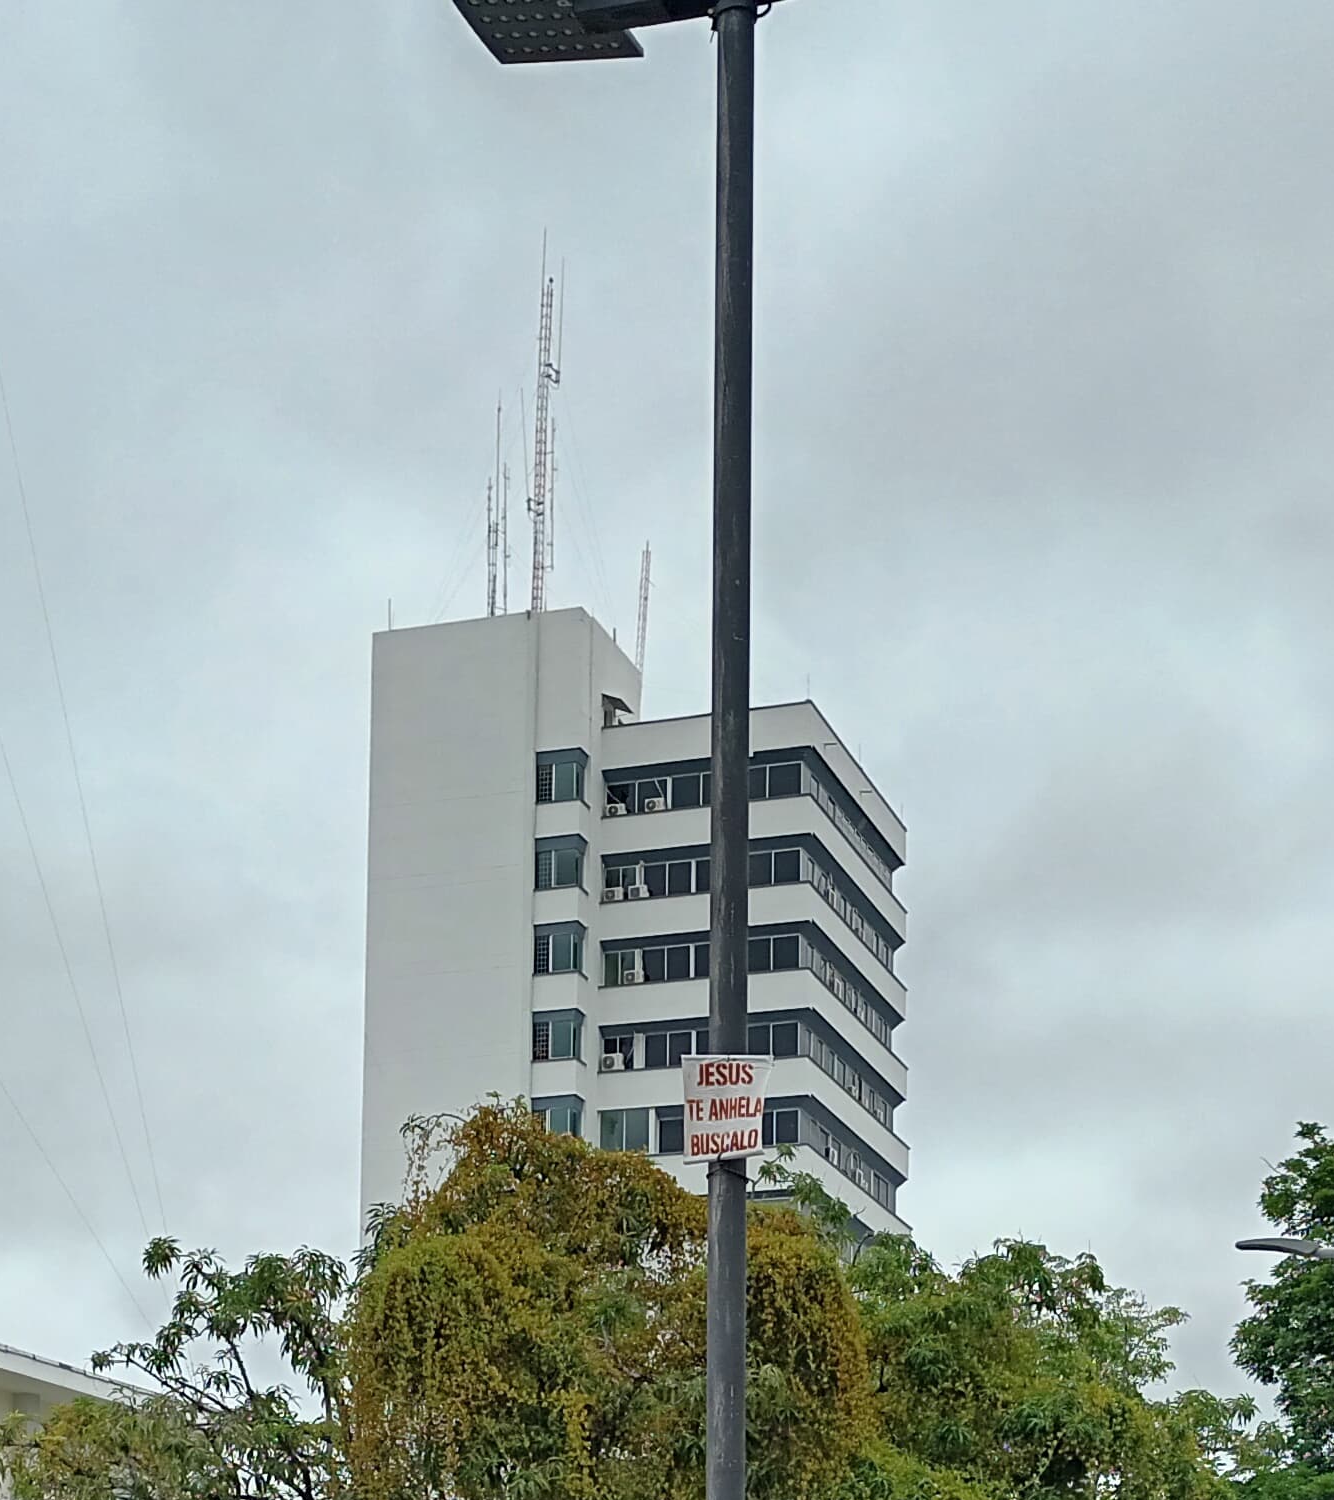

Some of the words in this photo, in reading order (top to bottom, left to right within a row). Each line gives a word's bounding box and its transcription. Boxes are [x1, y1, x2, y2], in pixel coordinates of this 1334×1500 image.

[697, 1062, 754, 1087] JESUS
[686, 1099, 704, 1121] TE
[709, 1096, 762, 1121] ANHELA
[690, 1128, 759, 1156] BUSCALO
